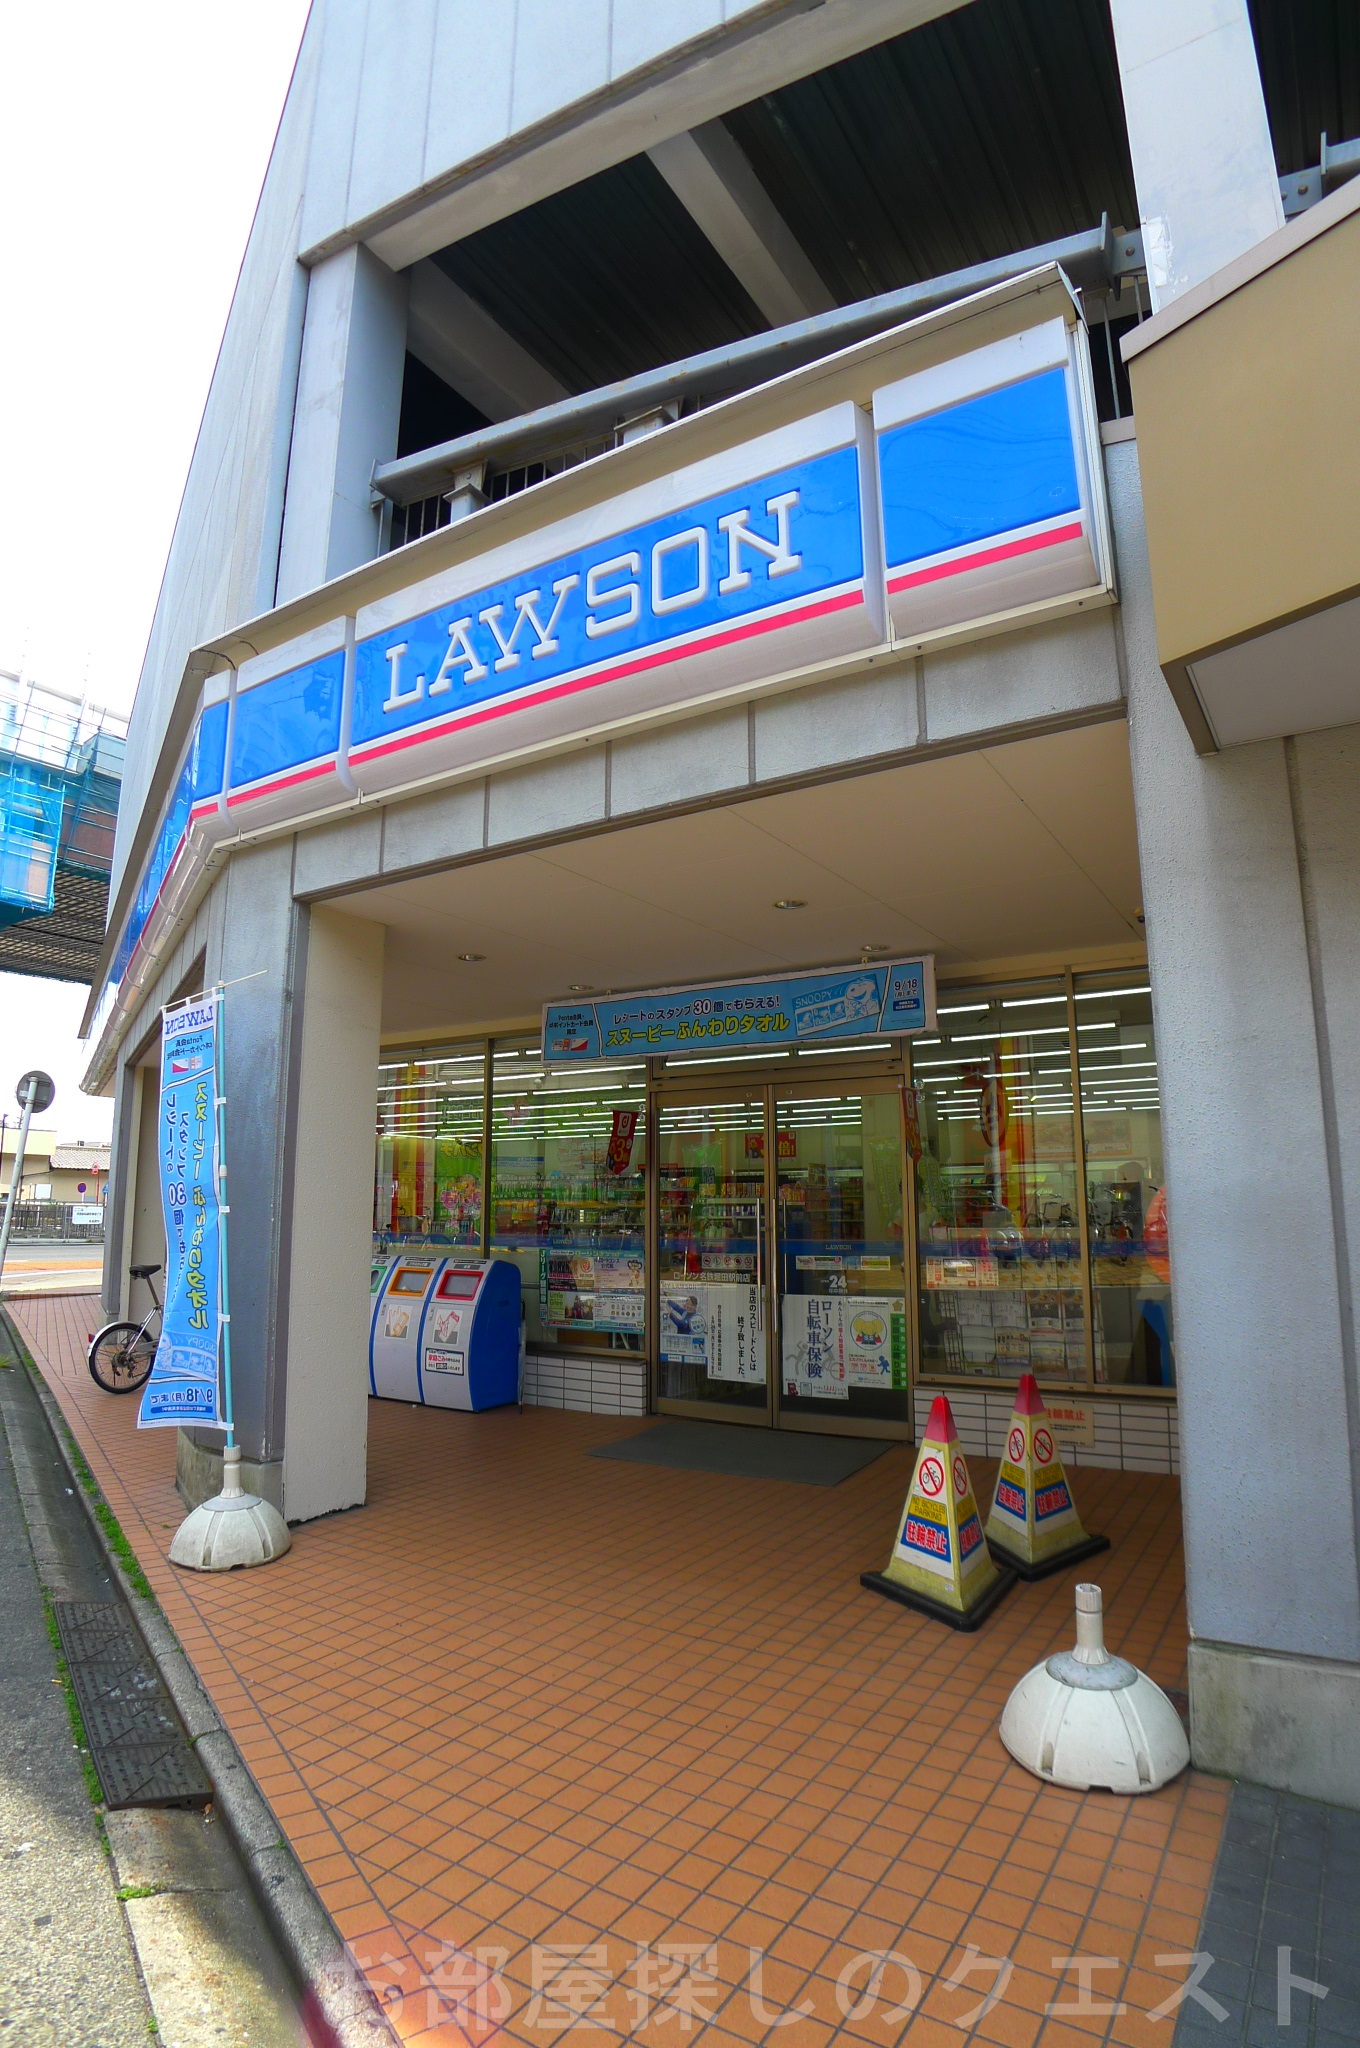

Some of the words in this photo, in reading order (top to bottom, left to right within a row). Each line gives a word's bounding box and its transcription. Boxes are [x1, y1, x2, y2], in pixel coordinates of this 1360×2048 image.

[383, 489, 802, 713] LAWSON
[794, 988, 834, 1008] SNOOPY
[893, 978, 918, 991] 9/18
[894, 989, 919, 998] (月)まで
[613, 995, 781, 1026] レシートのスタンプ30個でもらえる!
[606, 1012, 791, 1047] スヌーピーふんわりタオル
[829, 1275, 847, 1288] 24
[749, 1286, 757, 1372] 当店のスピードくじは
[806, 1299, 823, 1379] 自転車保険
[821, 1301, 834, 1353] ローソン
[737, 1315, 746, 1379] 終了致しました。
[912, 1496, 920, 1505] NO
[921, 1499, 946, 1515] BICYCLES
[914, 1505, 943, 1522] PARKING
[998, 1482, 1025, 1515] 駐輪禁止
[1036, 1486, 1069, 1516] 駐輪禁止
[906, 1519, 947, 1555] 駐輪禁止
